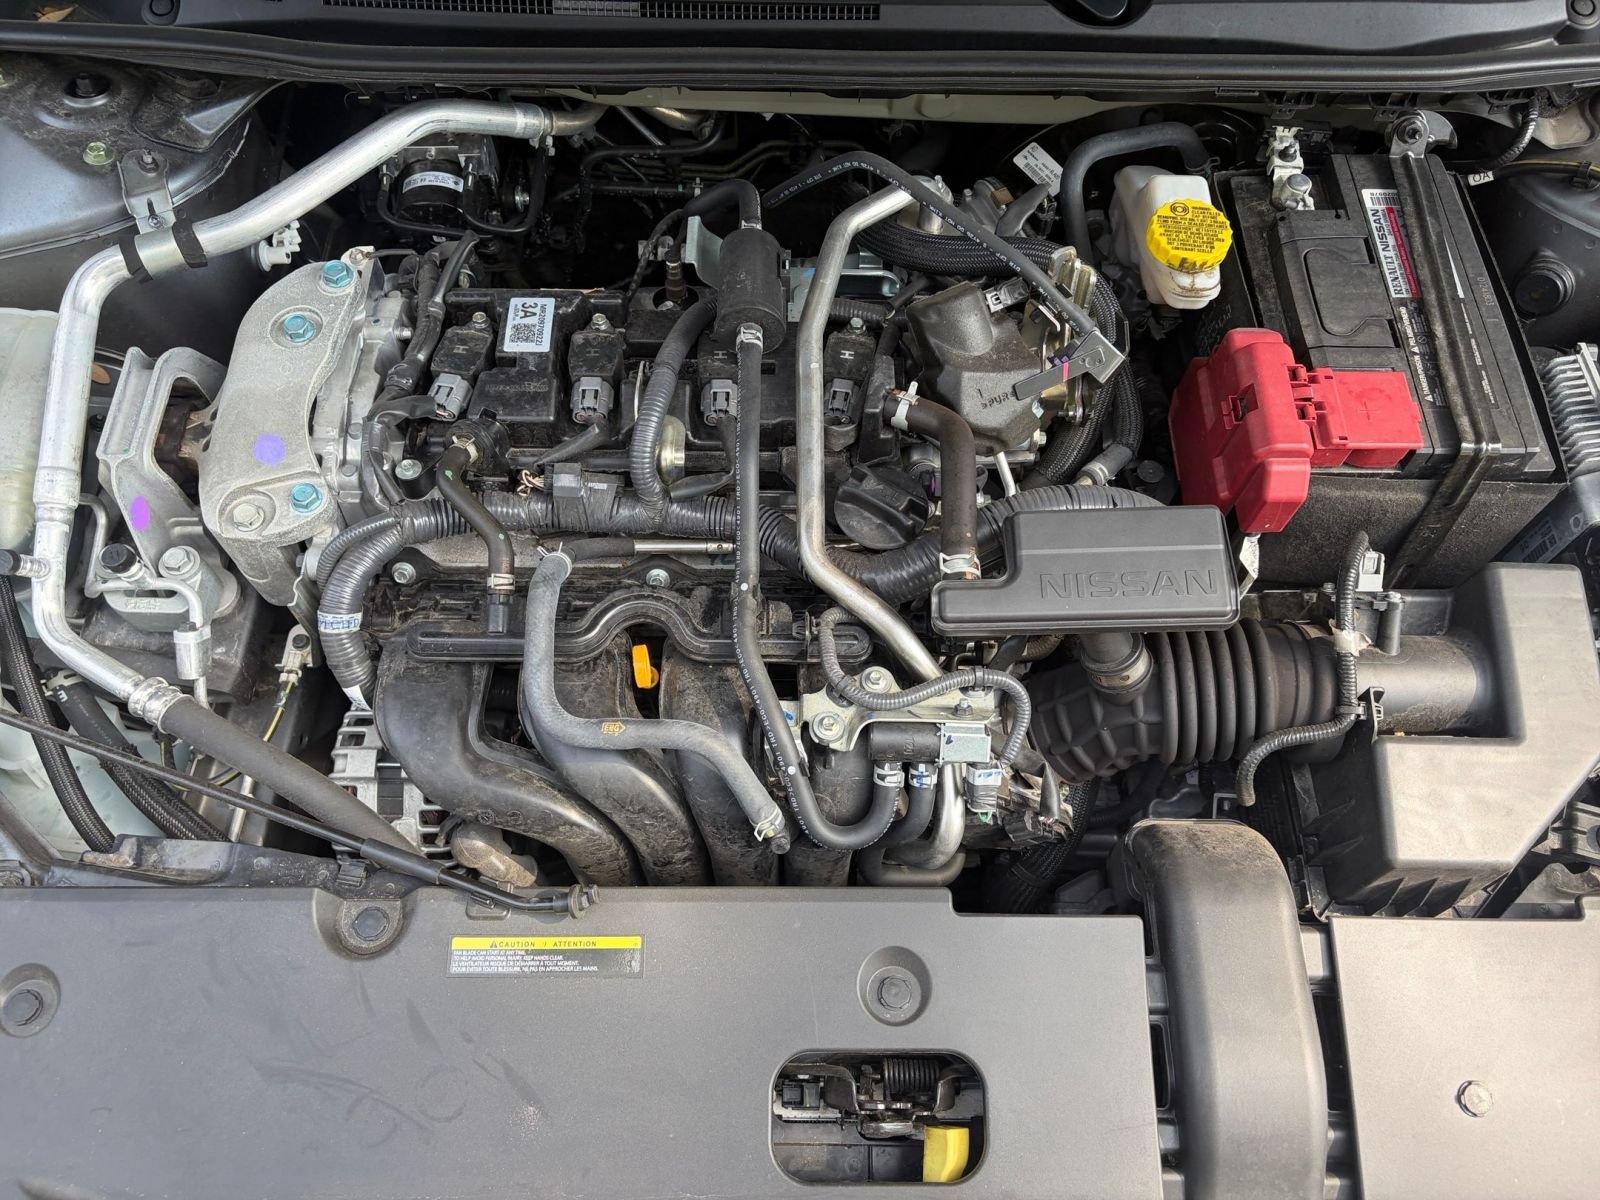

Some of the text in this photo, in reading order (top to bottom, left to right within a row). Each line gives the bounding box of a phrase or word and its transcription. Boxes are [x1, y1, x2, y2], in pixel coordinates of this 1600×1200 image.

[1370, 208, 1391, 252] NISSAN
[1385, 254, 1404, 295] RENAULT
[520, 302, 538, 319] 3A
[1039, 568, 1218, 599] NISSAN
